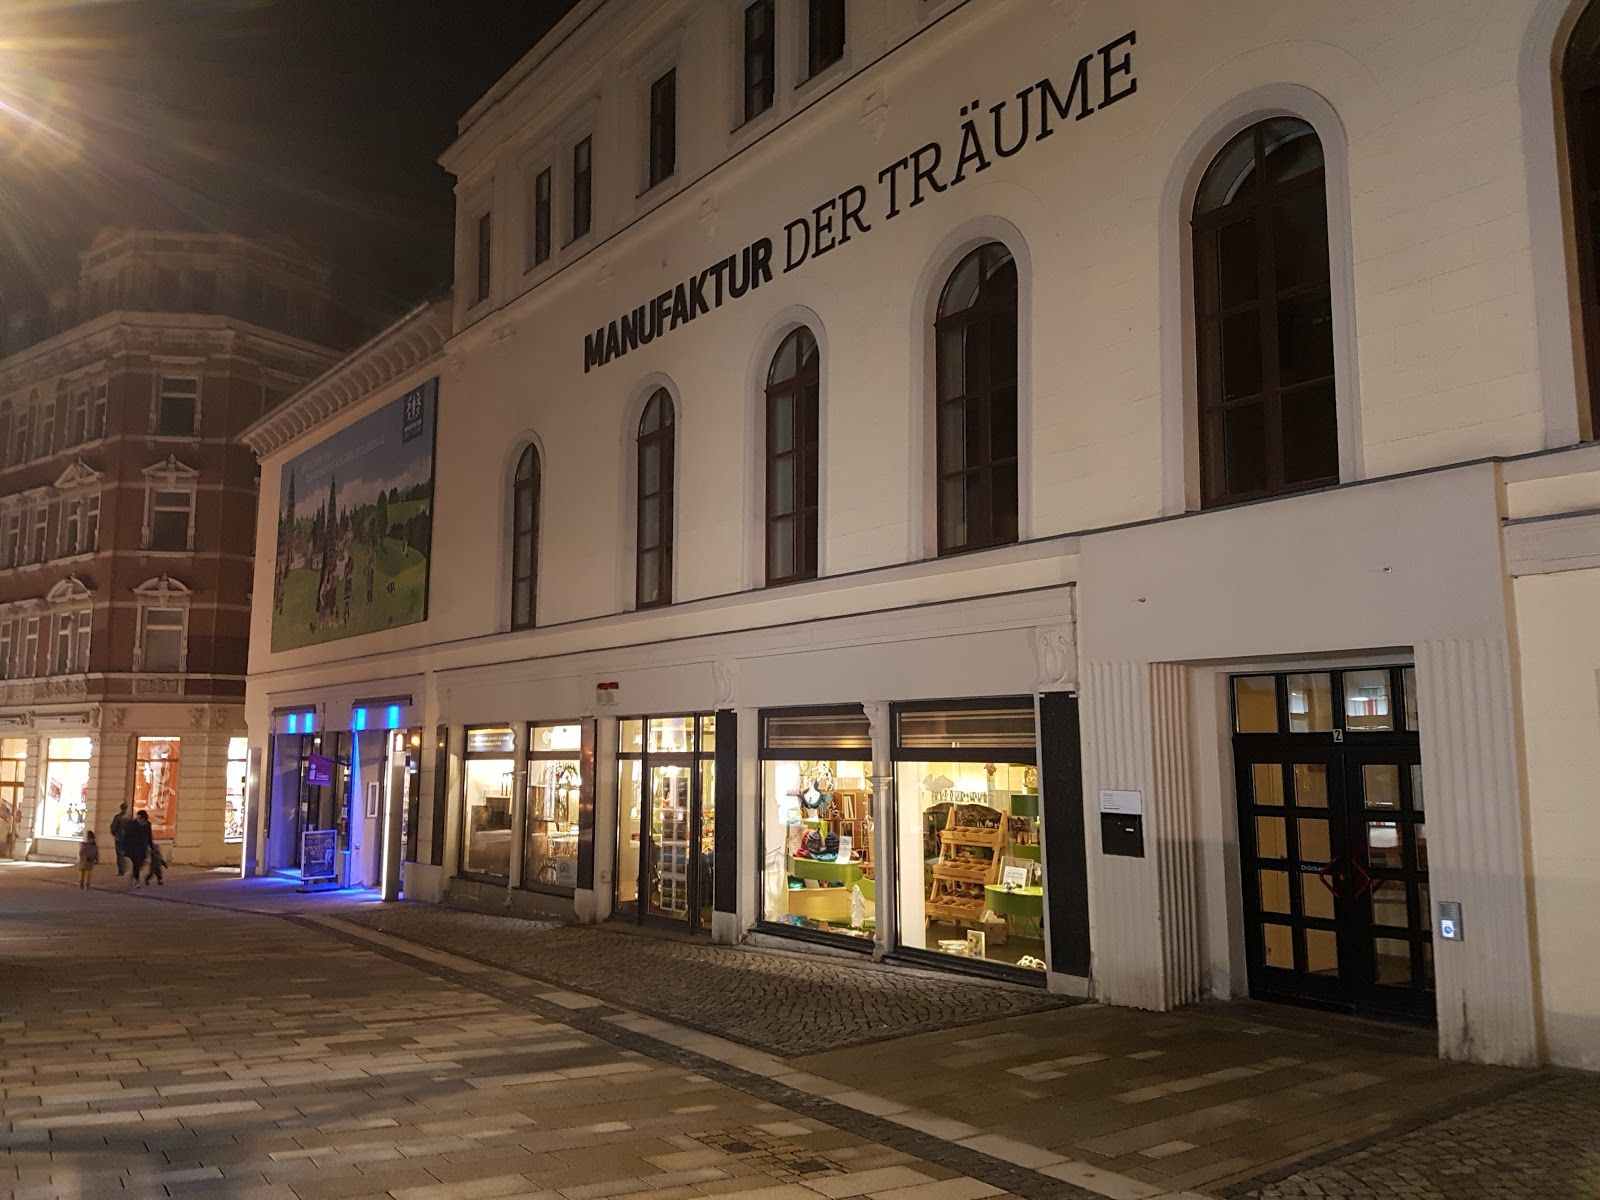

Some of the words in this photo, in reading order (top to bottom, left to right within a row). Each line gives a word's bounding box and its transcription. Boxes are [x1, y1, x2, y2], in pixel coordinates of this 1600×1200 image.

[584, 237, 773, 374] MANUFAKTUR
[783, 184, 872, 274] DER
[877, 30, 1138, 221] TRÄUME
